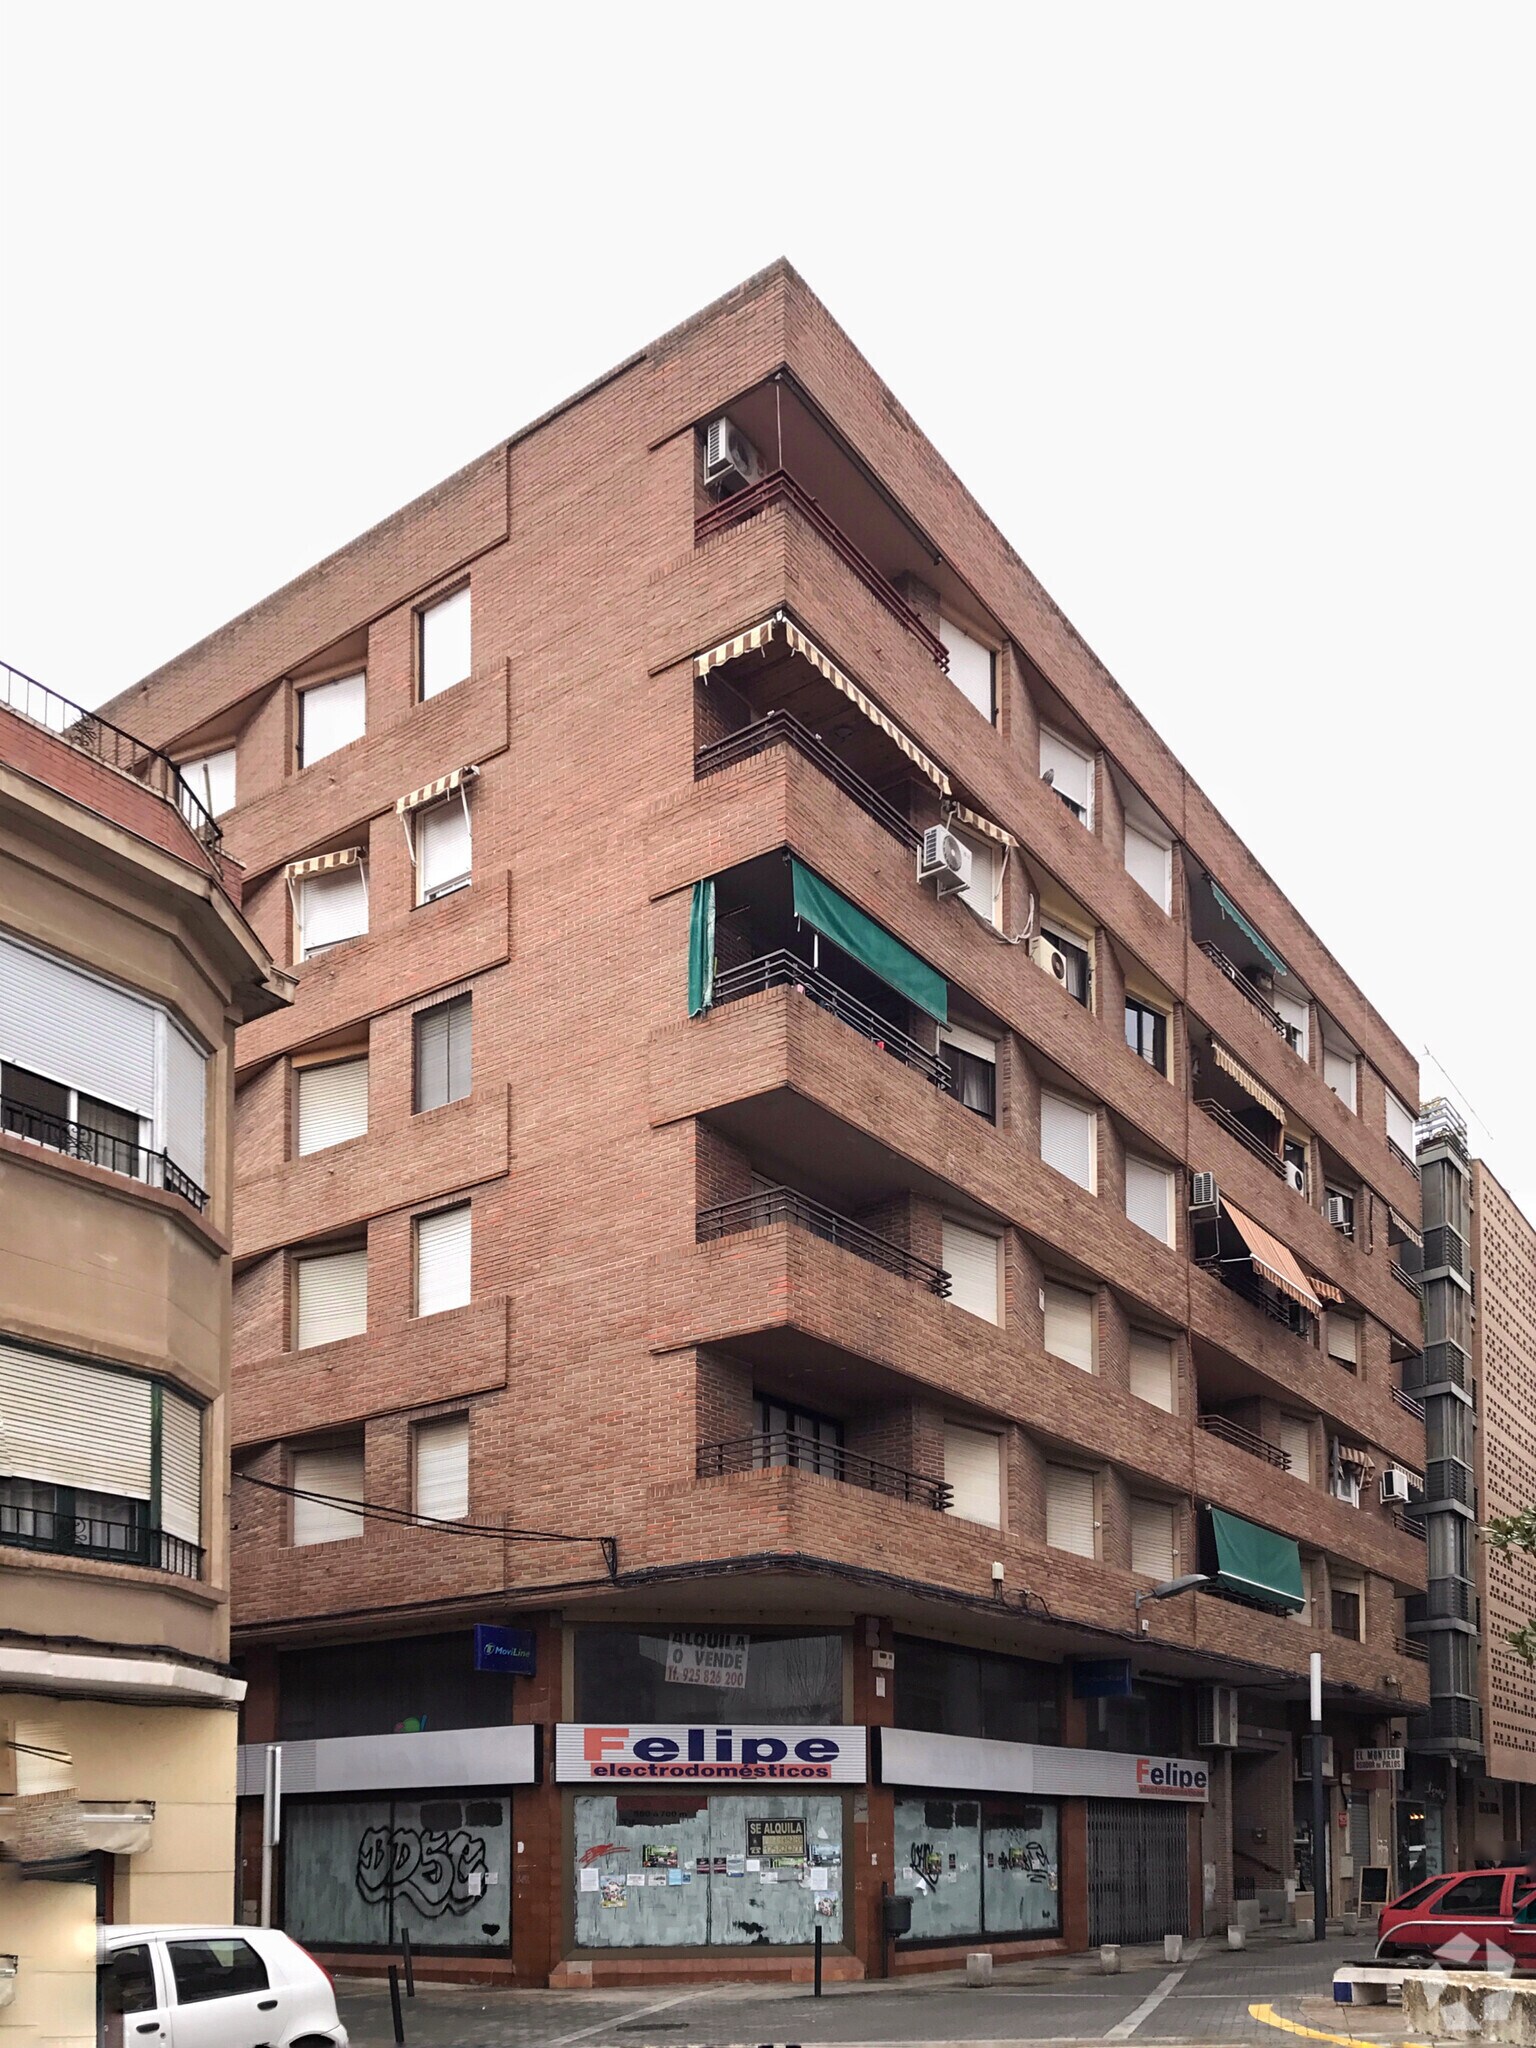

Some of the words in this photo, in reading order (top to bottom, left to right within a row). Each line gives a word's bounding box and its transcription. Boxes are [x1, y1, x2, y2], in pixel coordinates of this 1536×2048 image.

[673, 1632, 746, 1651] ALQUILA
[495, 1646, 530, 1657] MoviLine
[672, 1649, 683, 1664] O
[695, 1650, 743, 1670] VENDE
[683, 1667, 700, 1682] 925
[704, 1669, 721, 1684] 826
[725, 1671, 743, 1686] 200
[583, 1728, 840, 1764] Felipe
[1356, 1751, 1363, 1760] EL
[593, 1763, 828, 1778] electrodomésticos
[1136, 1758, 1207, 1788] Felipe
[750, 1822, 762, 1834] SE
[763, 1822, 803, 1834] ALQUILA
